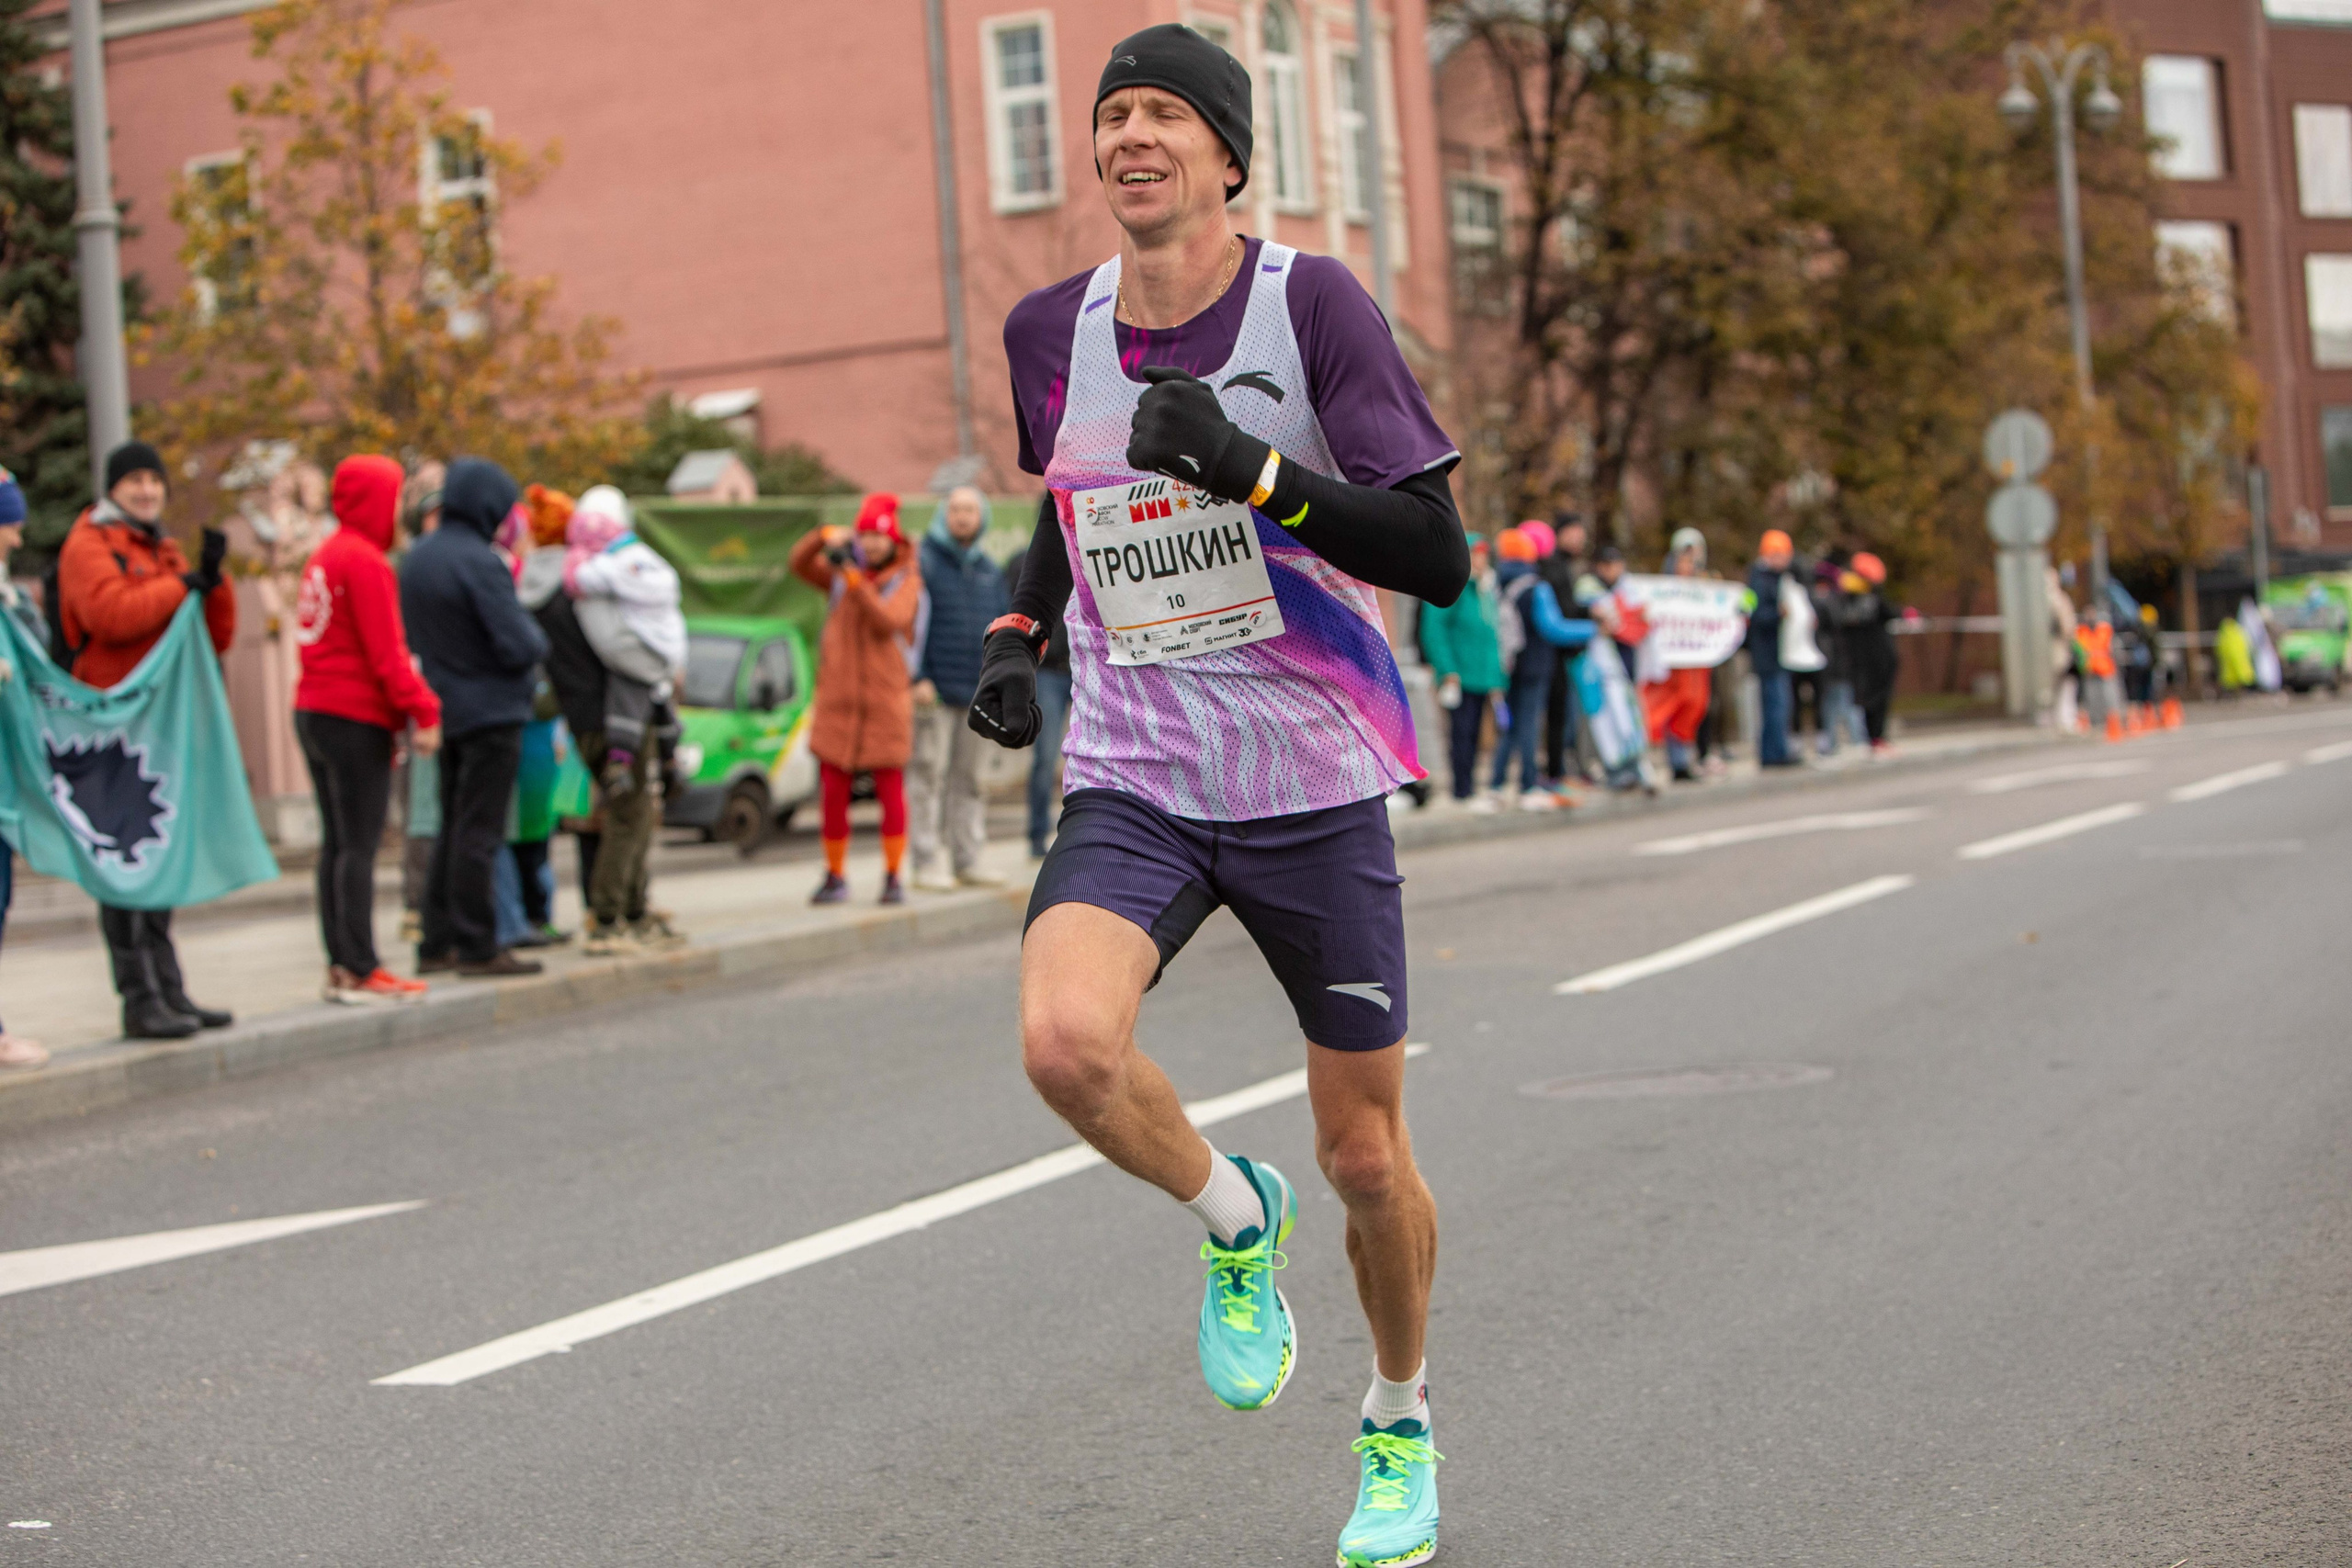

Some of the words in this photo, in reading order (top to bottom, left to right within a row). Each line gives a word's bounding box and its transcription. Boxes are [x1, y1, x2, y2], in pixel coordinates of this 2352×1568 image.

[1086, 521, 1252, 588] ТРОШКИН
[1167, 593, 1186, 610] 10
[1218, 613, 1248, 626] СИБУР
[1214, 632, 1238, 642] МАГНИТ
[1161, 642, 1191, 653] FONBET
